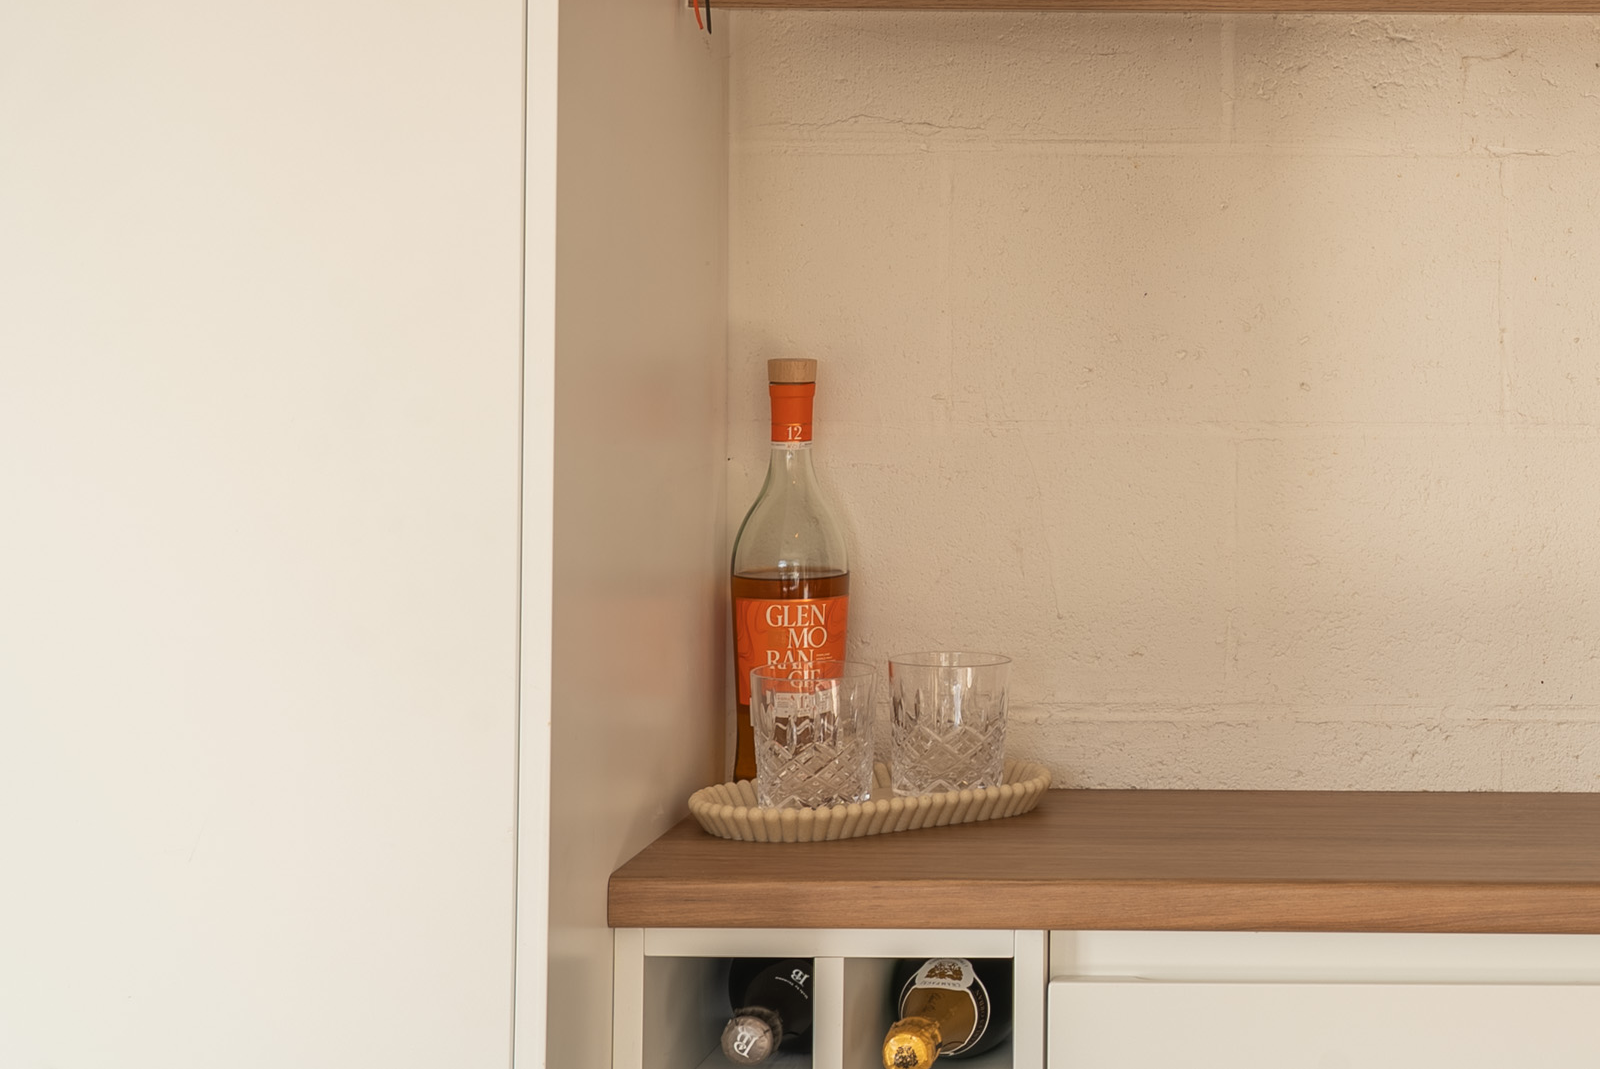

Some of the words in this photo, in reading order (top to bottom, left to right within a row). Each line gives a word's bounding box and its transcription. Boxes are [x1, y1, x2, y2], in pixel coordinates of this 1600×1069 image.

[787, 425, 803, 440] 12
[765, 603, 827, 627] GLEN
[787, 626, 828, 649] MO
[766, 648, 814, 670] RAN
